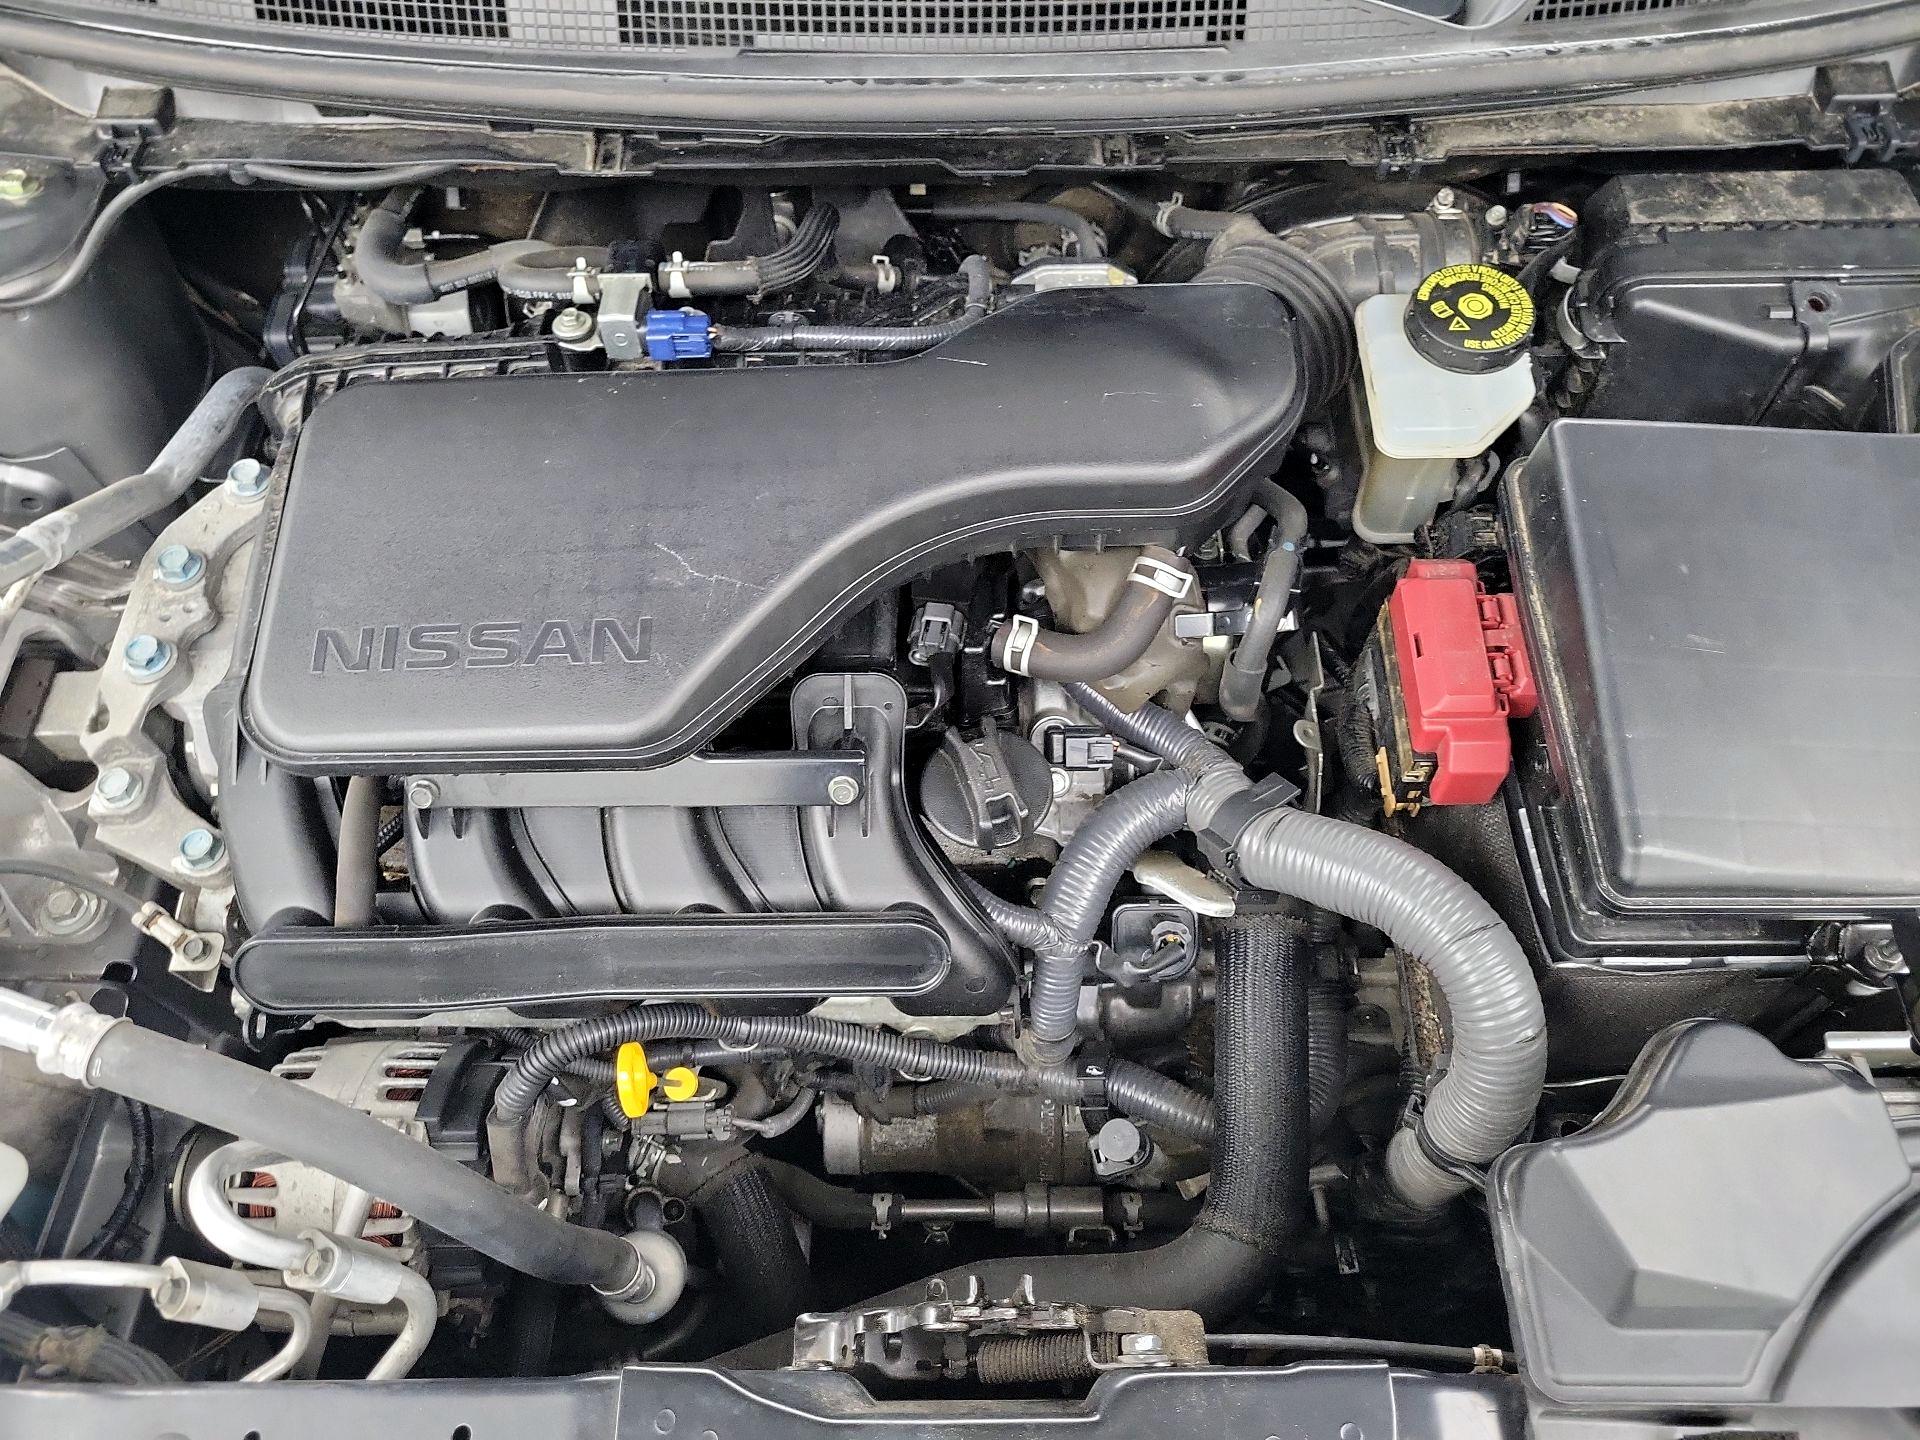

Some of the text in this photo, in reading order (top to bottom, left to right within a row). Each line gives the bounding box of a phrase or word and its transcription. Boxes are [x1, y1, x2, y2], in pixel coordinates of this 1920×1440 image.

[1441, 265, 1471, 277] SEALED
[1471, 265, 1479, 273] A
[1478, 266, 1502, 279] FROM
[1417, 271, 1445, 301] CONTAINER
[1500, 274, 1522, 291] FLUID
[1481, 283, 1511, 309] WARNING
[1515, 288, 1534, 309] BRAKE
[1438, 272, 1522, 339] CLEAN FILLER CAP BEFORE REMOVING
[1515, 322, 1530, 335] OR
[1464, 339, 1482, 348] USE
[1481, 338, 1504, 349] ONLY
[311, 616, 652, 673] NISSAN
